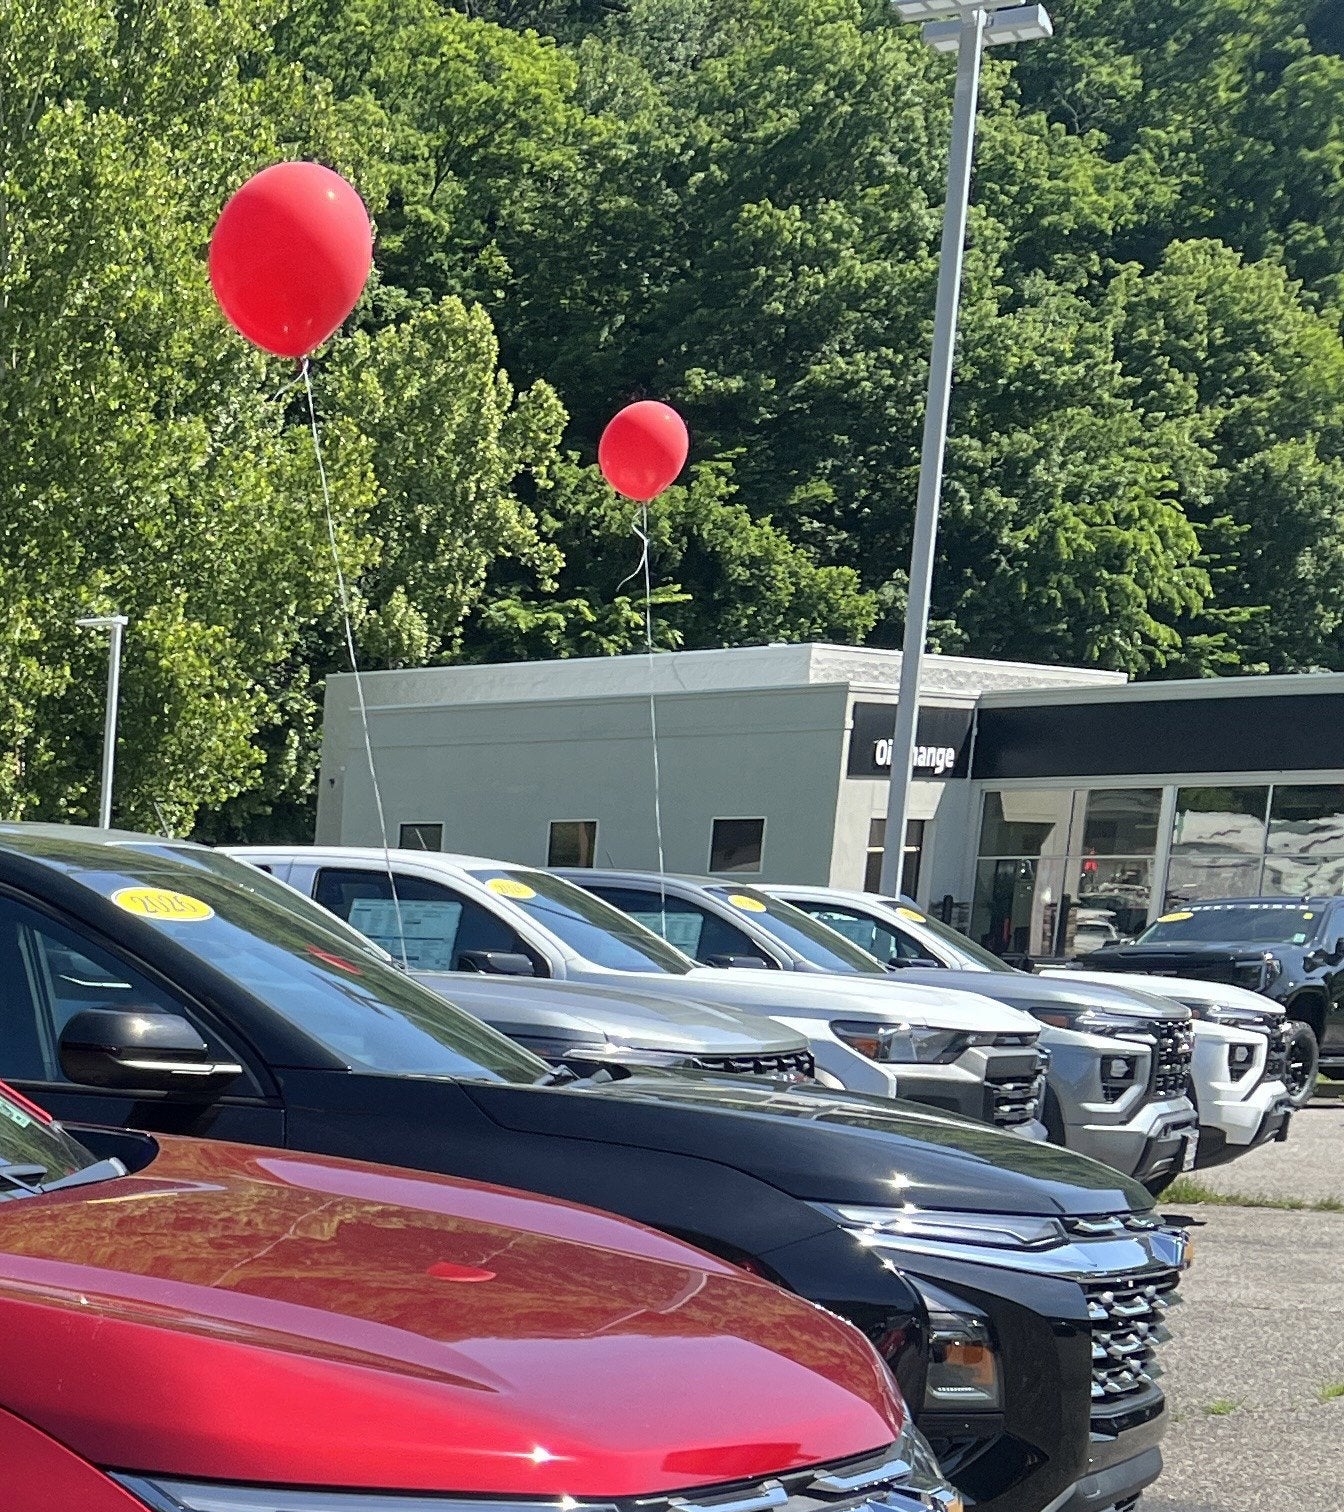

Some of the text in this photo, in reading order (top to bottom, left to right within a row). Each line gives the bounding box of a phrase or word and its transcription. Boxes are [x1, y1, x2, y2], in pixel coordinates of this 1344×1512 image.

[875, 738, 894, 766] Oi
[912, 746, 955, 775] ange
[130, 895, 198, 913] 2026
